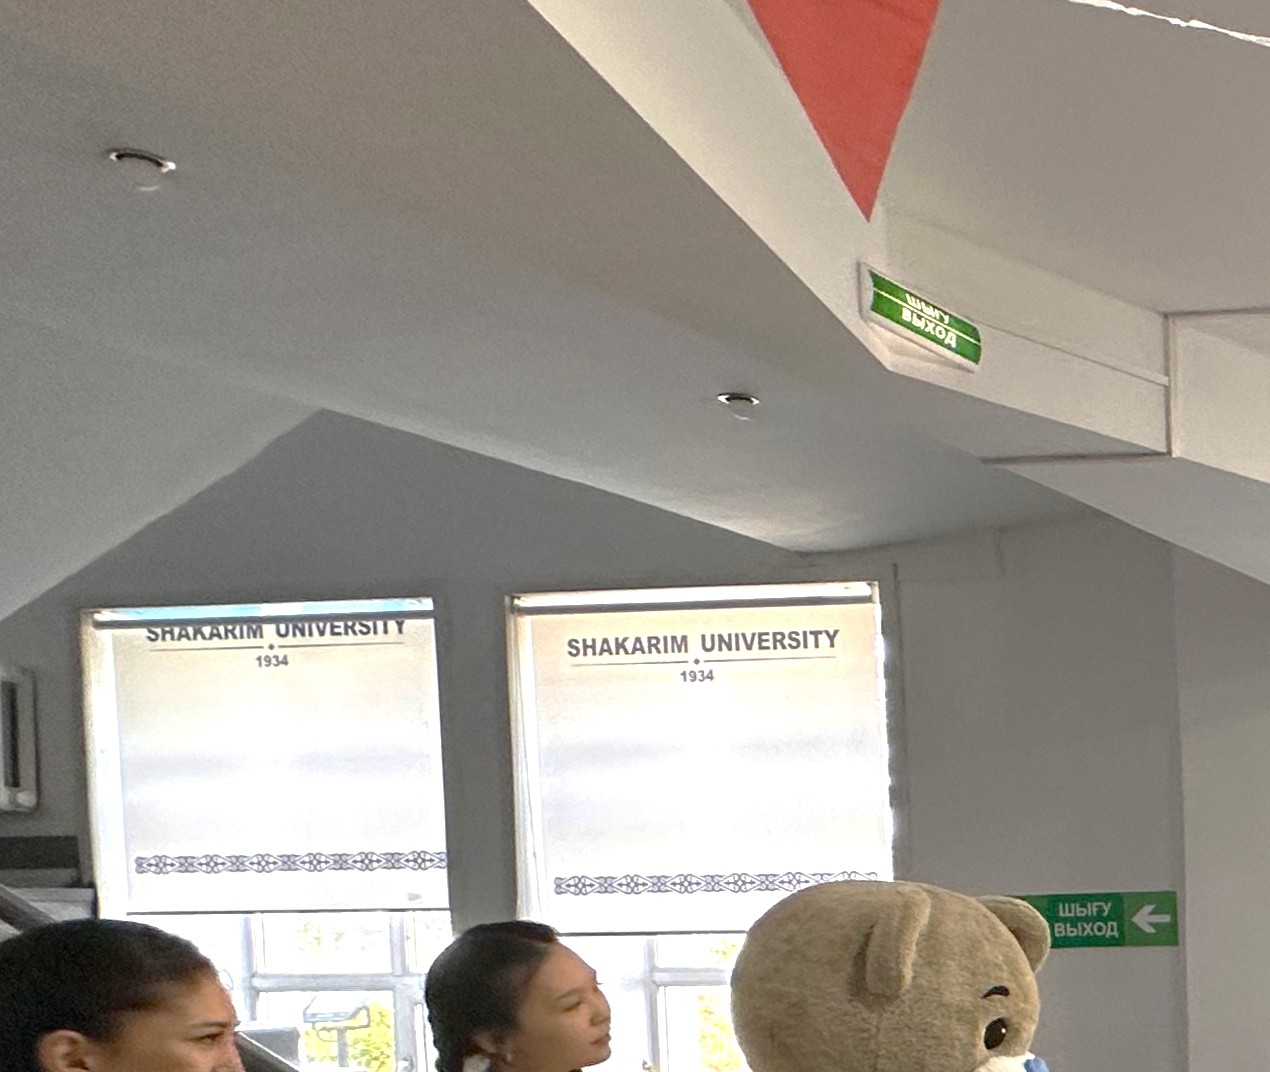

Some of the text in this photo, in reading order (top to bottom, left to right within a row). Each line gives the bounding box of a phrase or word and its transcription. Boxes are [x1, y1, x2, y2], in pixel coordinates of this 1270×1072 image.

[901, 307, 956, 348] ВЫХОД
[146, 619, 406, 642] SHAKARIM UNIVERSITY
[567, 629, 840, 657] SHAKARIM UNIVERSITY
[255, 654, 289, 668] 1934
[680, 669, 715, 682] 1934
[1053, 921, 1119, 938] ВЫХОД
